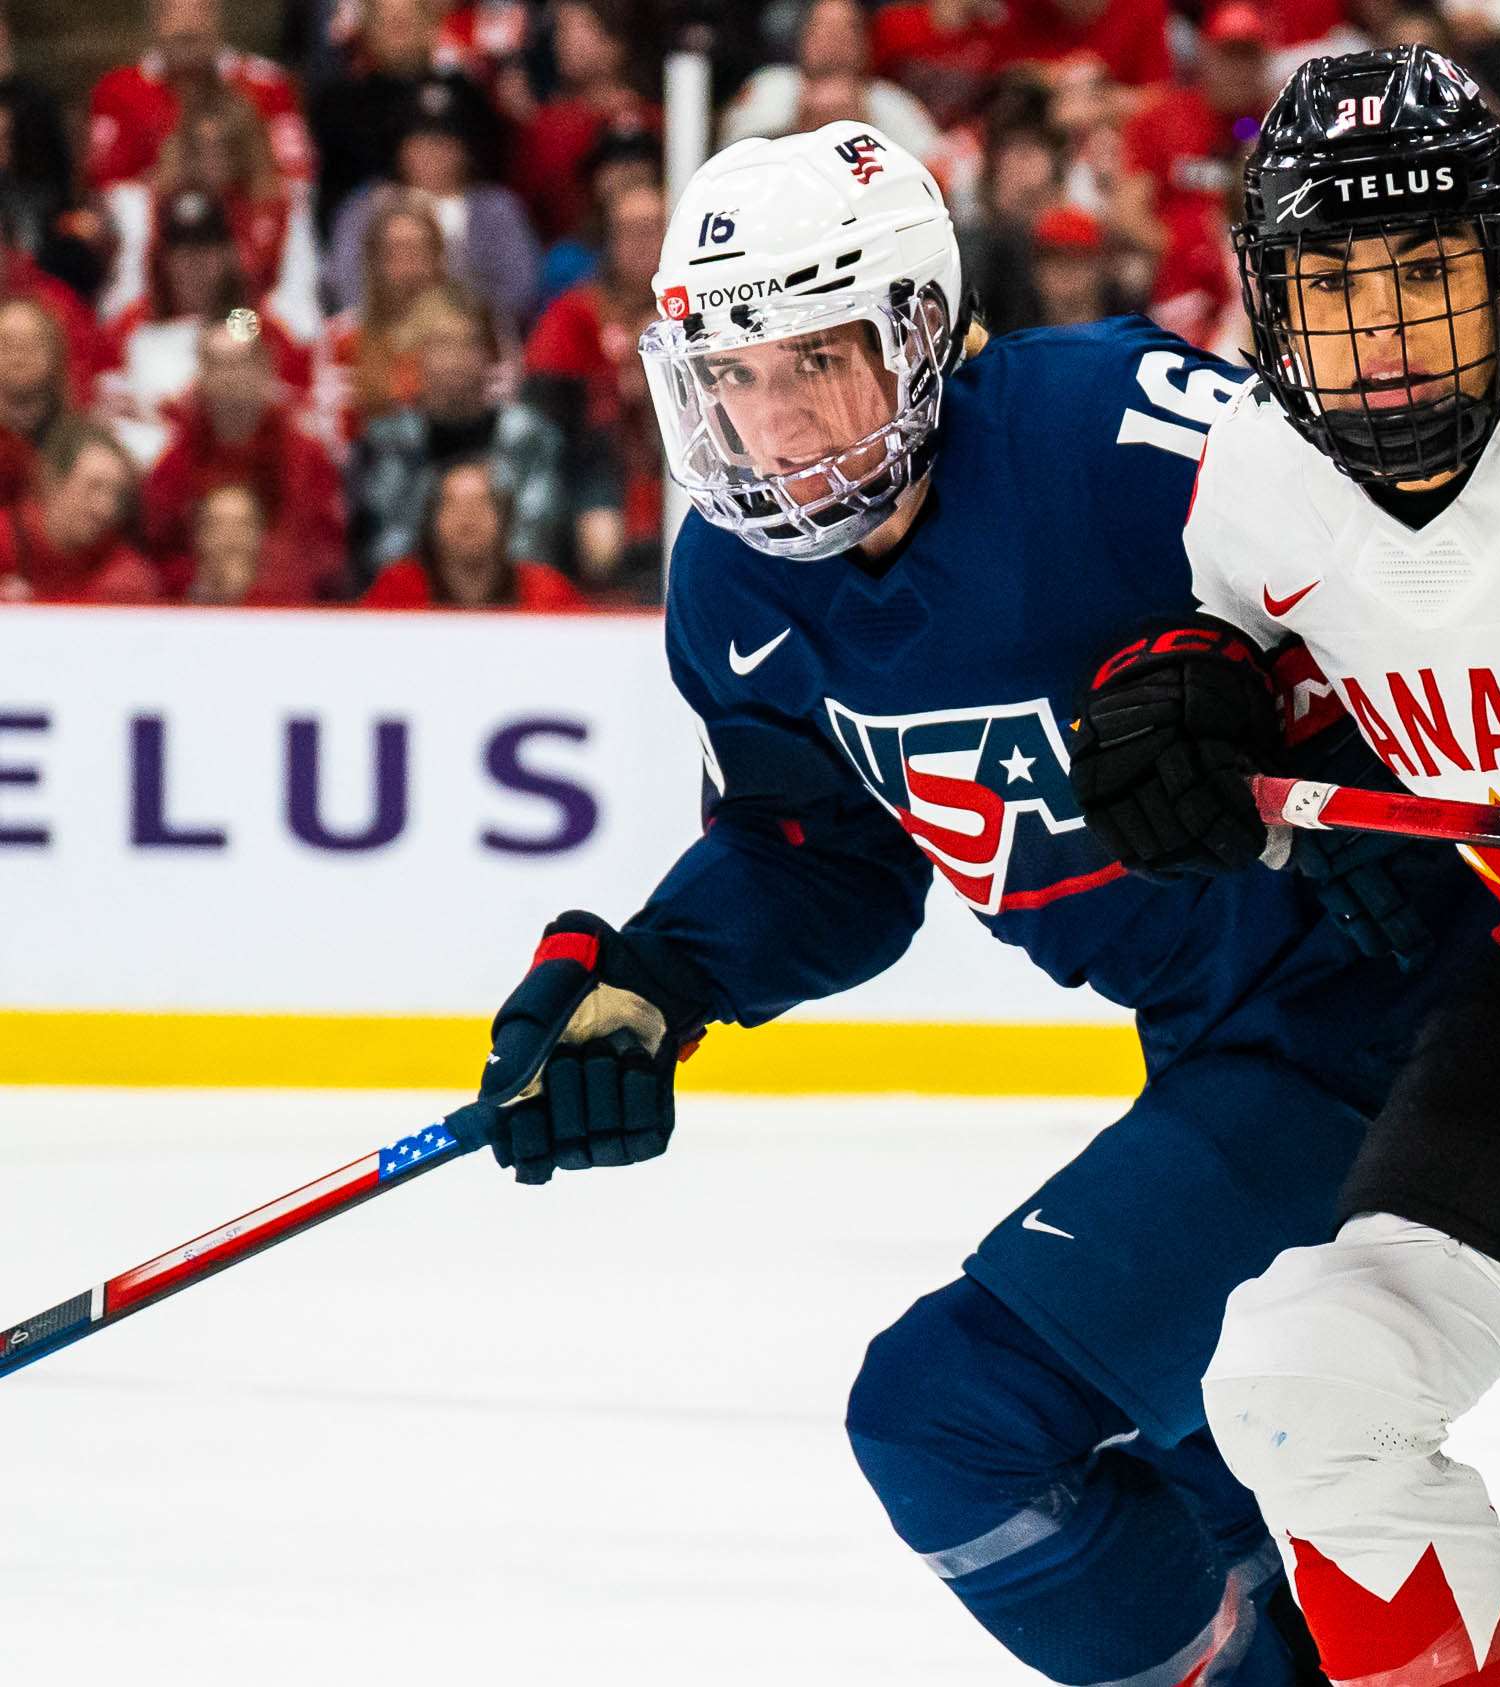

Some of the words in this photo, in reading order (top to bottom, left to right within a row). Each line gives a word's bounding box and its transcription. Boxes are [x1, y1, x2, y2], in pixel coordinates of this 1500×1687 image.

[1336, 96, 1385, 128] 20
[1335, 167, 1454, 202] TELUS
[699, 209, 739, 248] 16
[697, 278, 783, 310] TOYOTA
[1116, 350, 1233, 463] 16
[0, 711, 600, 856] ELUS
[824, 697, 1085, 916] USA
